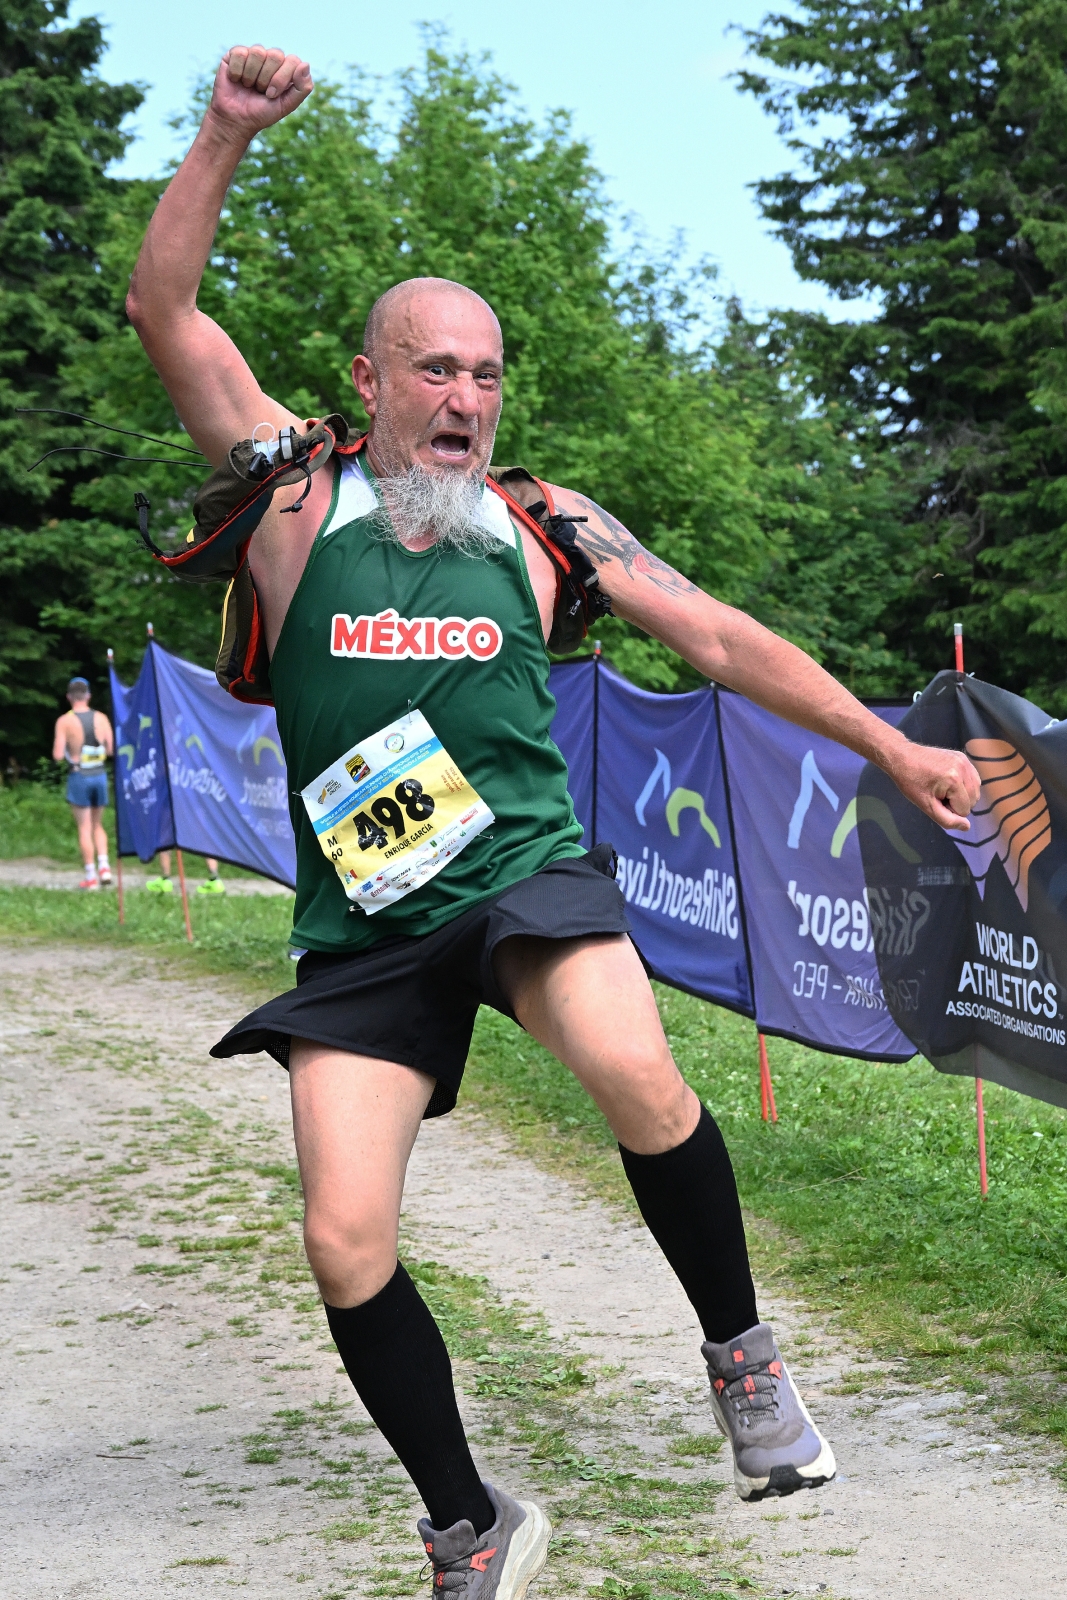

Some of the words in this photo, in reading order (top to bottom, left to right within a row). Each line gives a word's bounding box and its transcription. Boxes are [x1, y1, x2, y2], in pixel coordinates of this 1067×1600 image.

[331, 608, 503, 661] MÉXICO
[352, 778, 435, 851] 498
[327, 835, 338, 848] M
[331, 848, 343, 860] 60
[384, 838, 412, 859] ENRIQUE
[410, 823, 434, 841] GARCÍA
[976, 922, 1039, 970] WORLD
[958, 961, 1058, 1018] ATHLETICS
[946, 1001, 1002, 1026] ASSOCIATED
[1002, 1014, 1066, 1046] ORGANISATIONS
